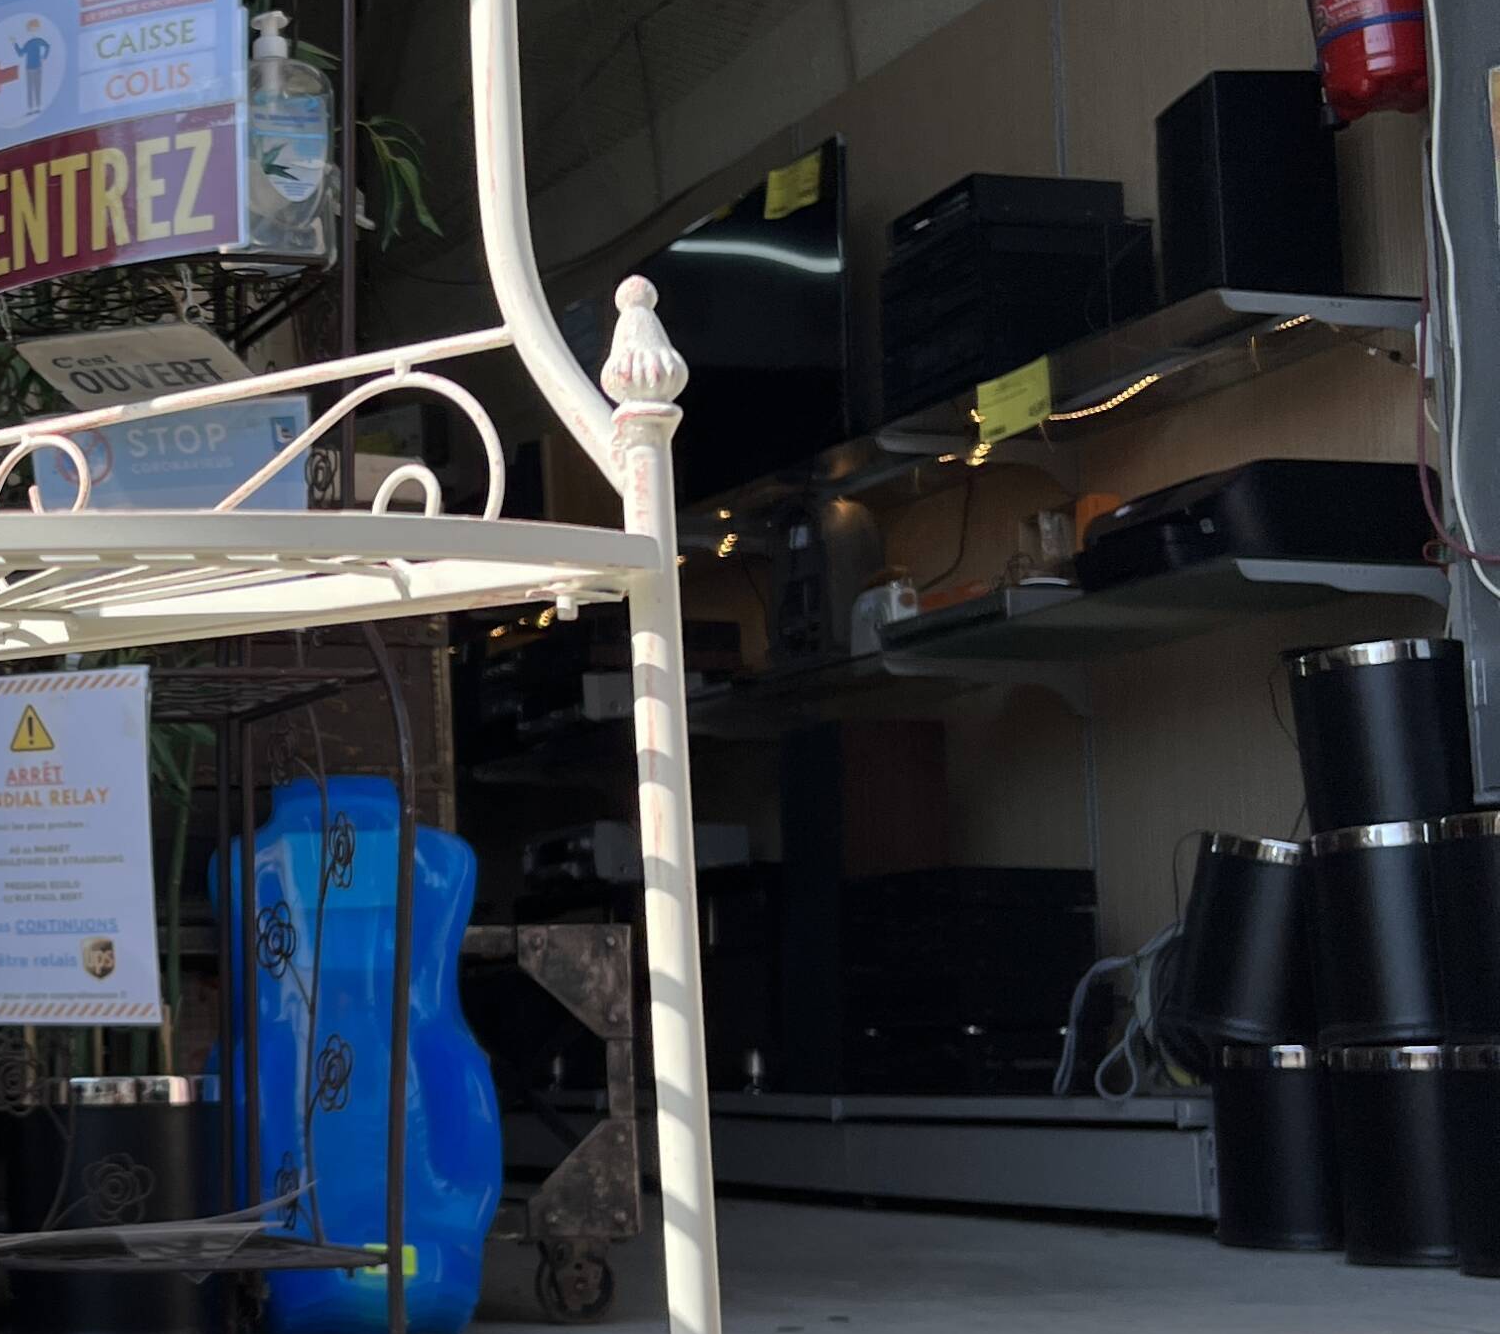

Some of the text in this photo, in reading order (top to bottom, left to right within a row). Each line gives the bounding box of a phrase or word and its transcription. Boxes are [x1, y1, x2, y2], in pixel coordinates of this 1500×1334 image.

[96, 19, 196, 59] CAISSE
[105, 62, 192, 101] COLIS
[69, 358, 224, 394] OUVERT
[127, 423, 228, 458] STOP
[132, 456, 235, 474] CORONAVIRUS
[6, 761, 64, 785] ARRÊT
[49, 787, 110, 806] RELAY
[15, 918, 119, 935] CONTINUONS
[33, 952, 78, 967] relais
